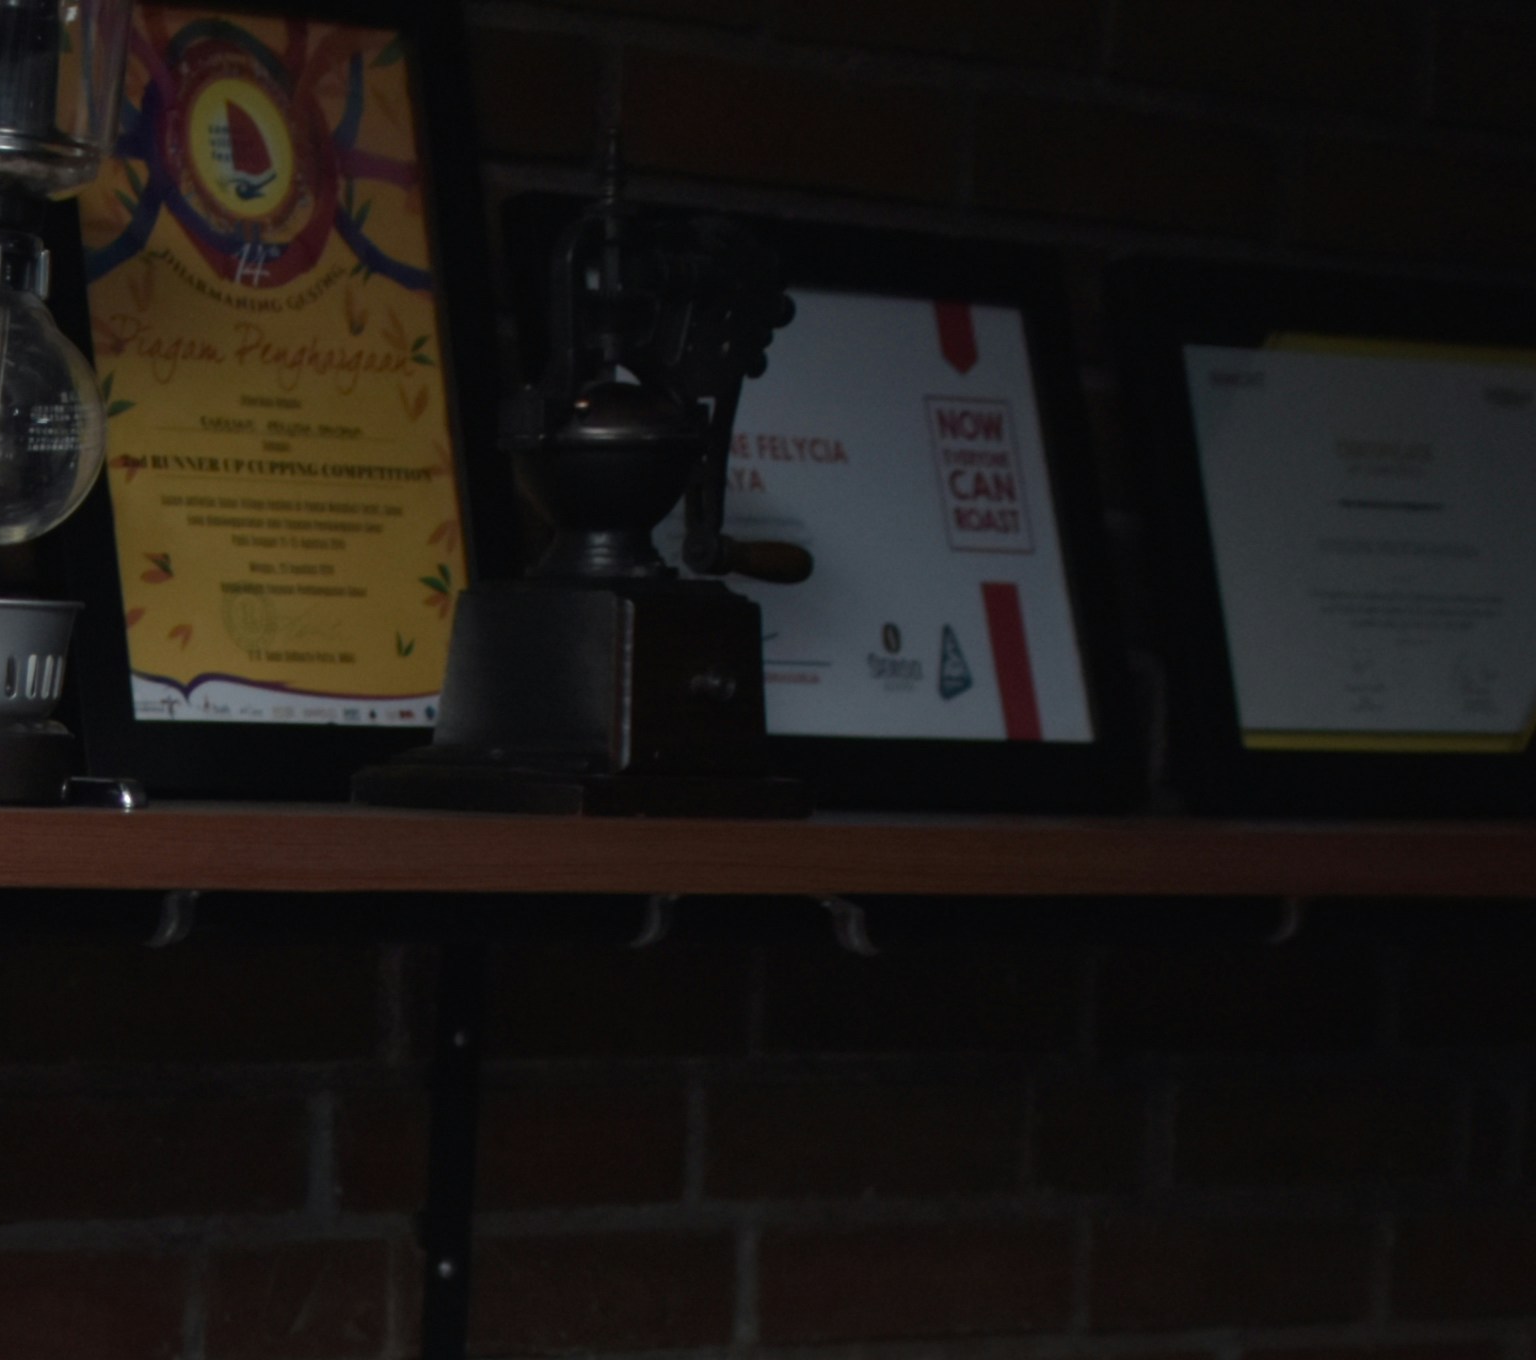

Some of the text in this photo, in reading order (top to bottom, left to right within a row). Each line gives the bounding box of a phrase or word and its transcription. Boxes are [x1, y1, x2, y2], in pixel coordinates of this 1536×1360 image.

[936, 409, 1004, 441] NOW
[756, 434, 849, 465] FELYCIA
[151, 454, 221, 473] RUNNER
[224, 458, 245, 474] UP
[248, 459, 319, 479] CUPPING
[322, 462, 434, 483] COMPETITION
[948, 469, 1017, 503] CAN
